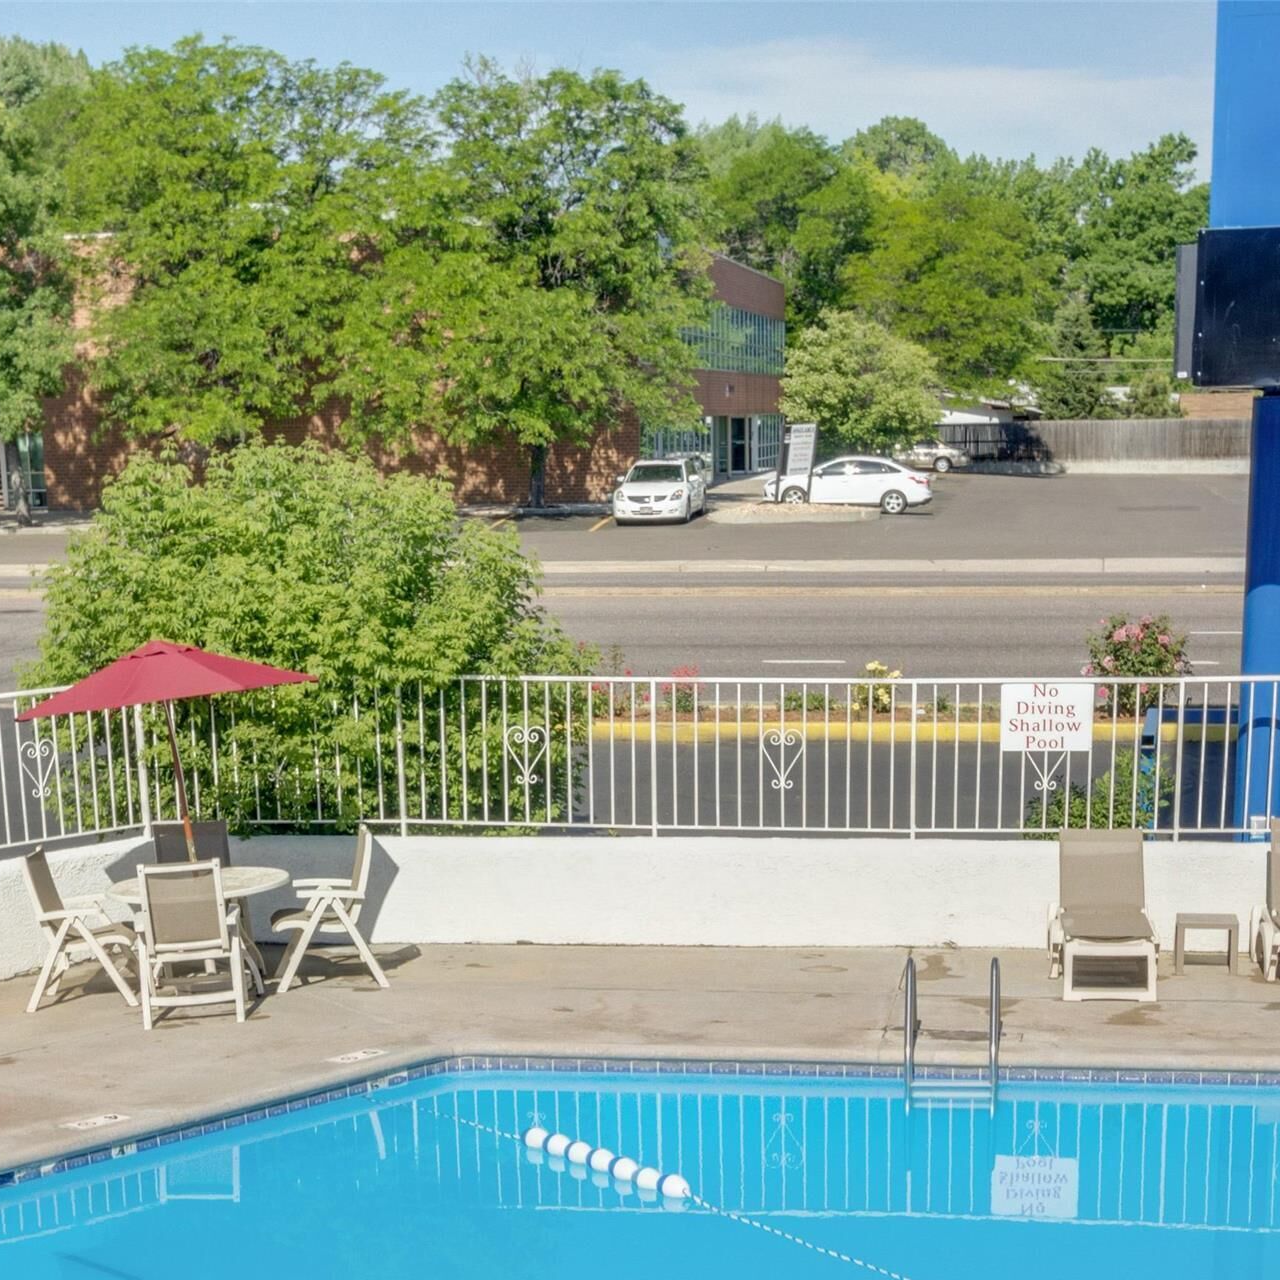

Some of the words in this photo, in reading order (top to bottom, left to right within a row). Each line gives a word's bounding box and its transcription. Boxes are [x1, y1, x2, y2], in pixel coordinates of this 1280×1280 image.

[1033, 684, 1059, 698] No
[1017, 701, 1076, 717] Diving
[1008, 719, 1081, 732] Shallow
[1025, 736, 1064, 749] Pool
